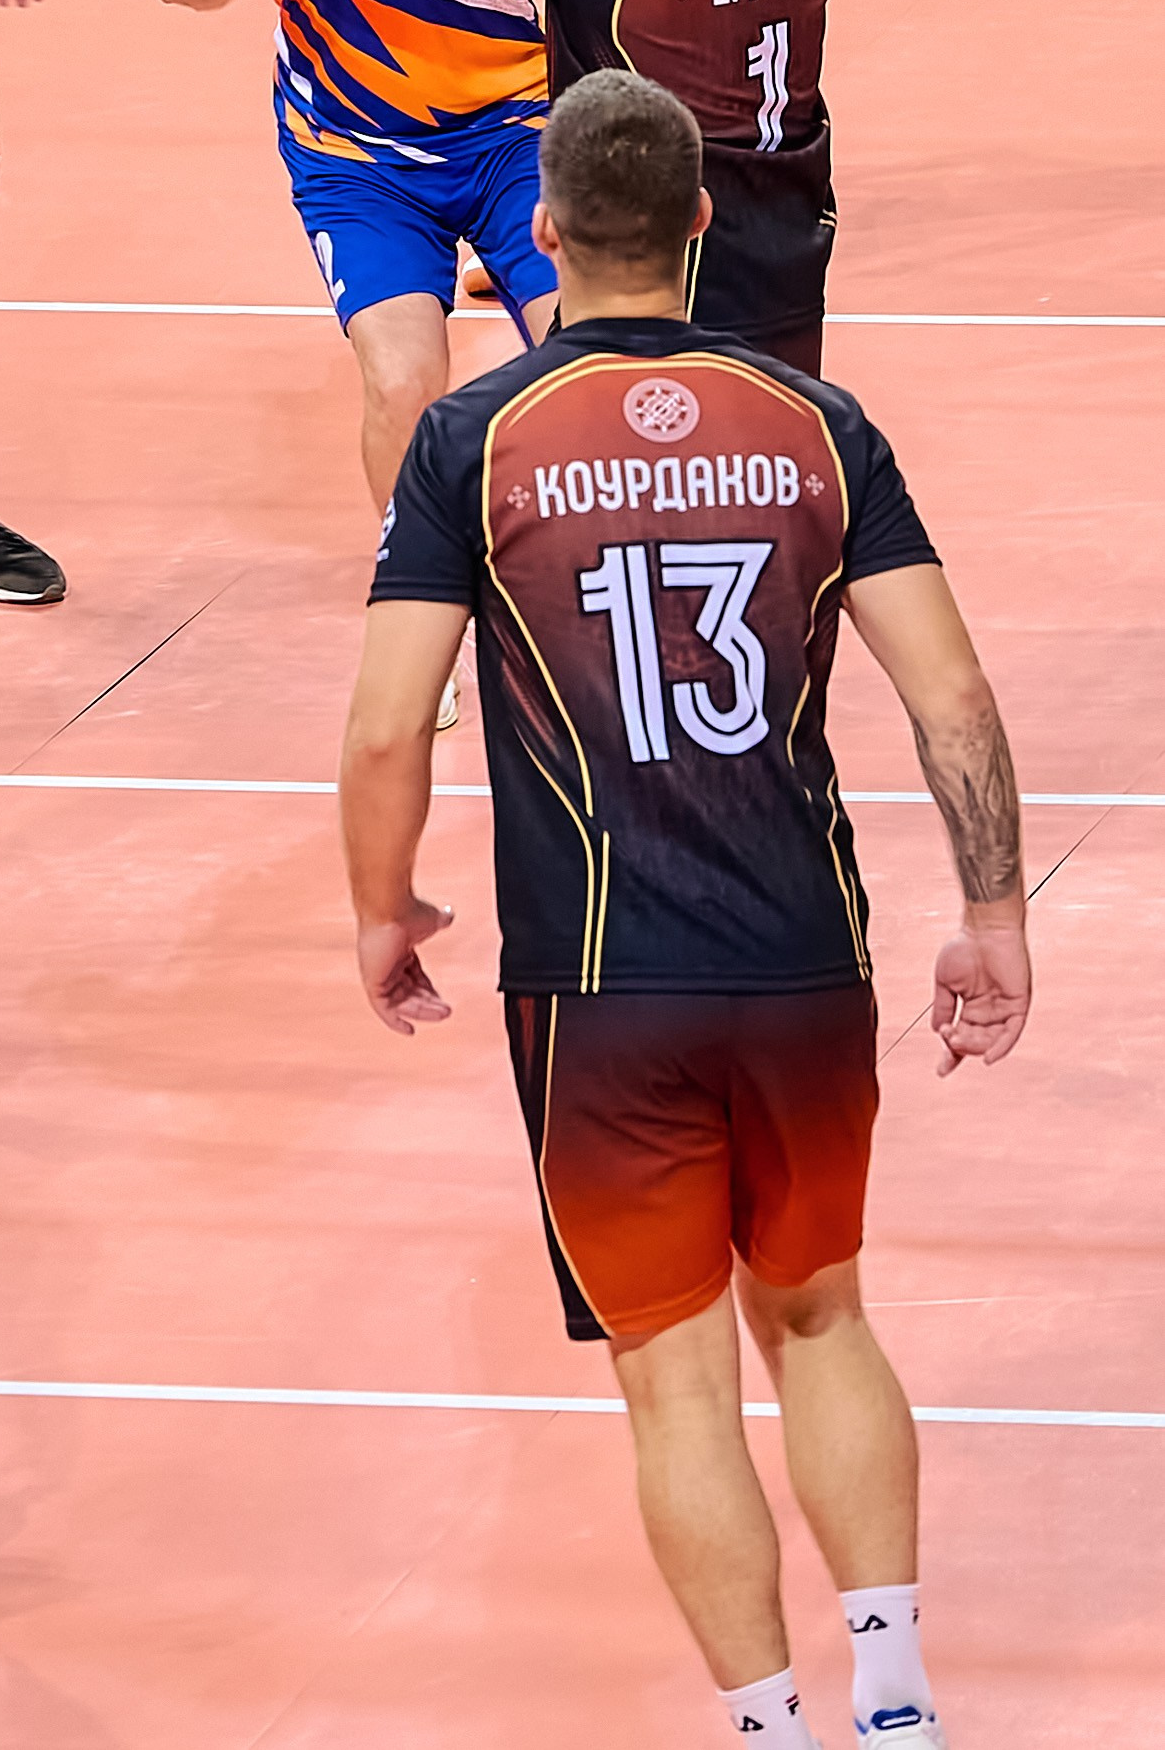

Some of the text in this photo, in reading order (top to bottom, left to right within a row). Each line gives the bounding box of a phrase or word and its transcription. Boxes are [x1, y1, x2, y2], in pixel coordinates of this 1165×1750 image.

[747, 21, 789, 152] 1
[534, 453, 800, 519] КОУРДАКОВ
[579, 542, 773, 763] 13
